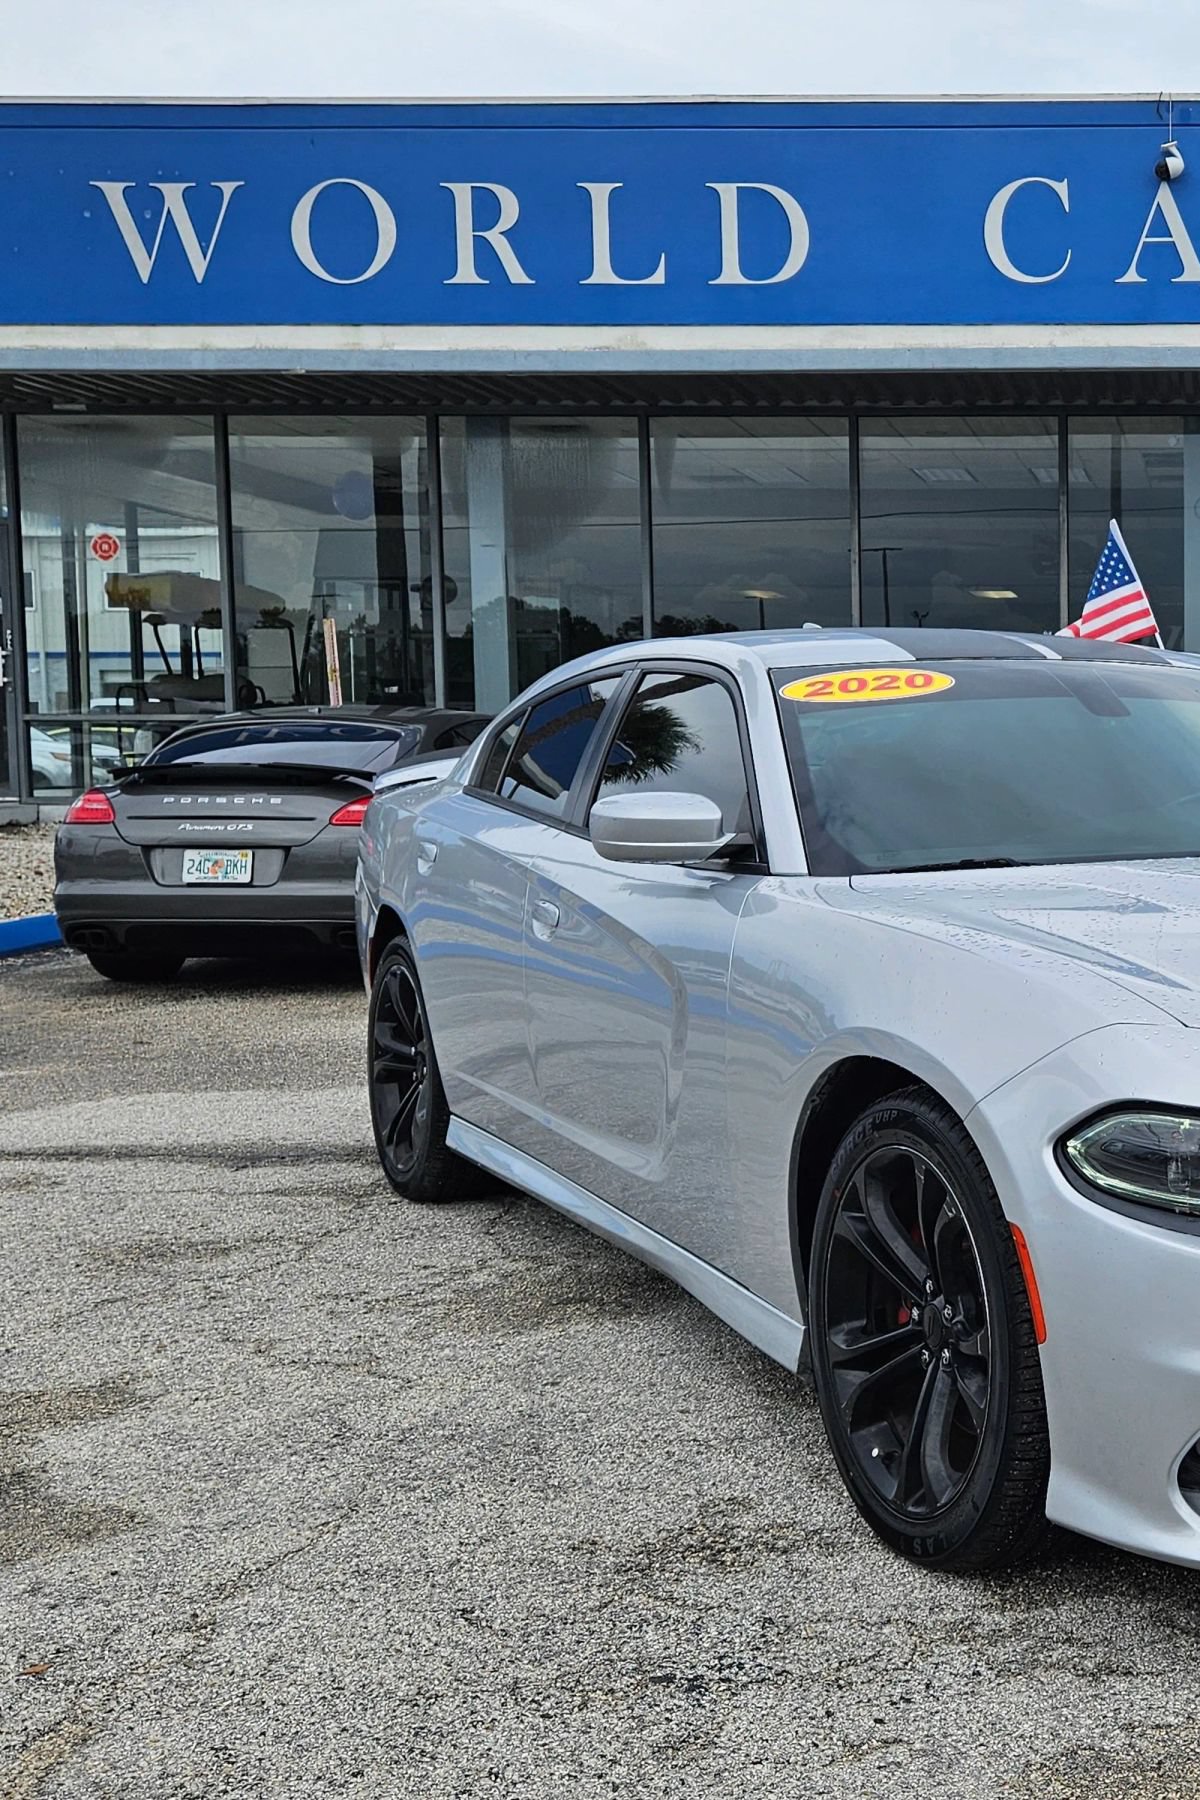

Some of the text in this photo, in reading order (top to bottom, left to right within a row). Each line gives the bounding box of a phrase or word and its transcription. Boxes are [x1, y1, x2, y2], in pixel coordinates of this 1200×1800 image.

[89, 178, 811, 286] WORLD
[802, 673, 935, 698] 2020
[162, 796, 283, 804] PORSCHE
[226, 823, 254, 831] GTS
[225, 858, 248, 875] BKH
